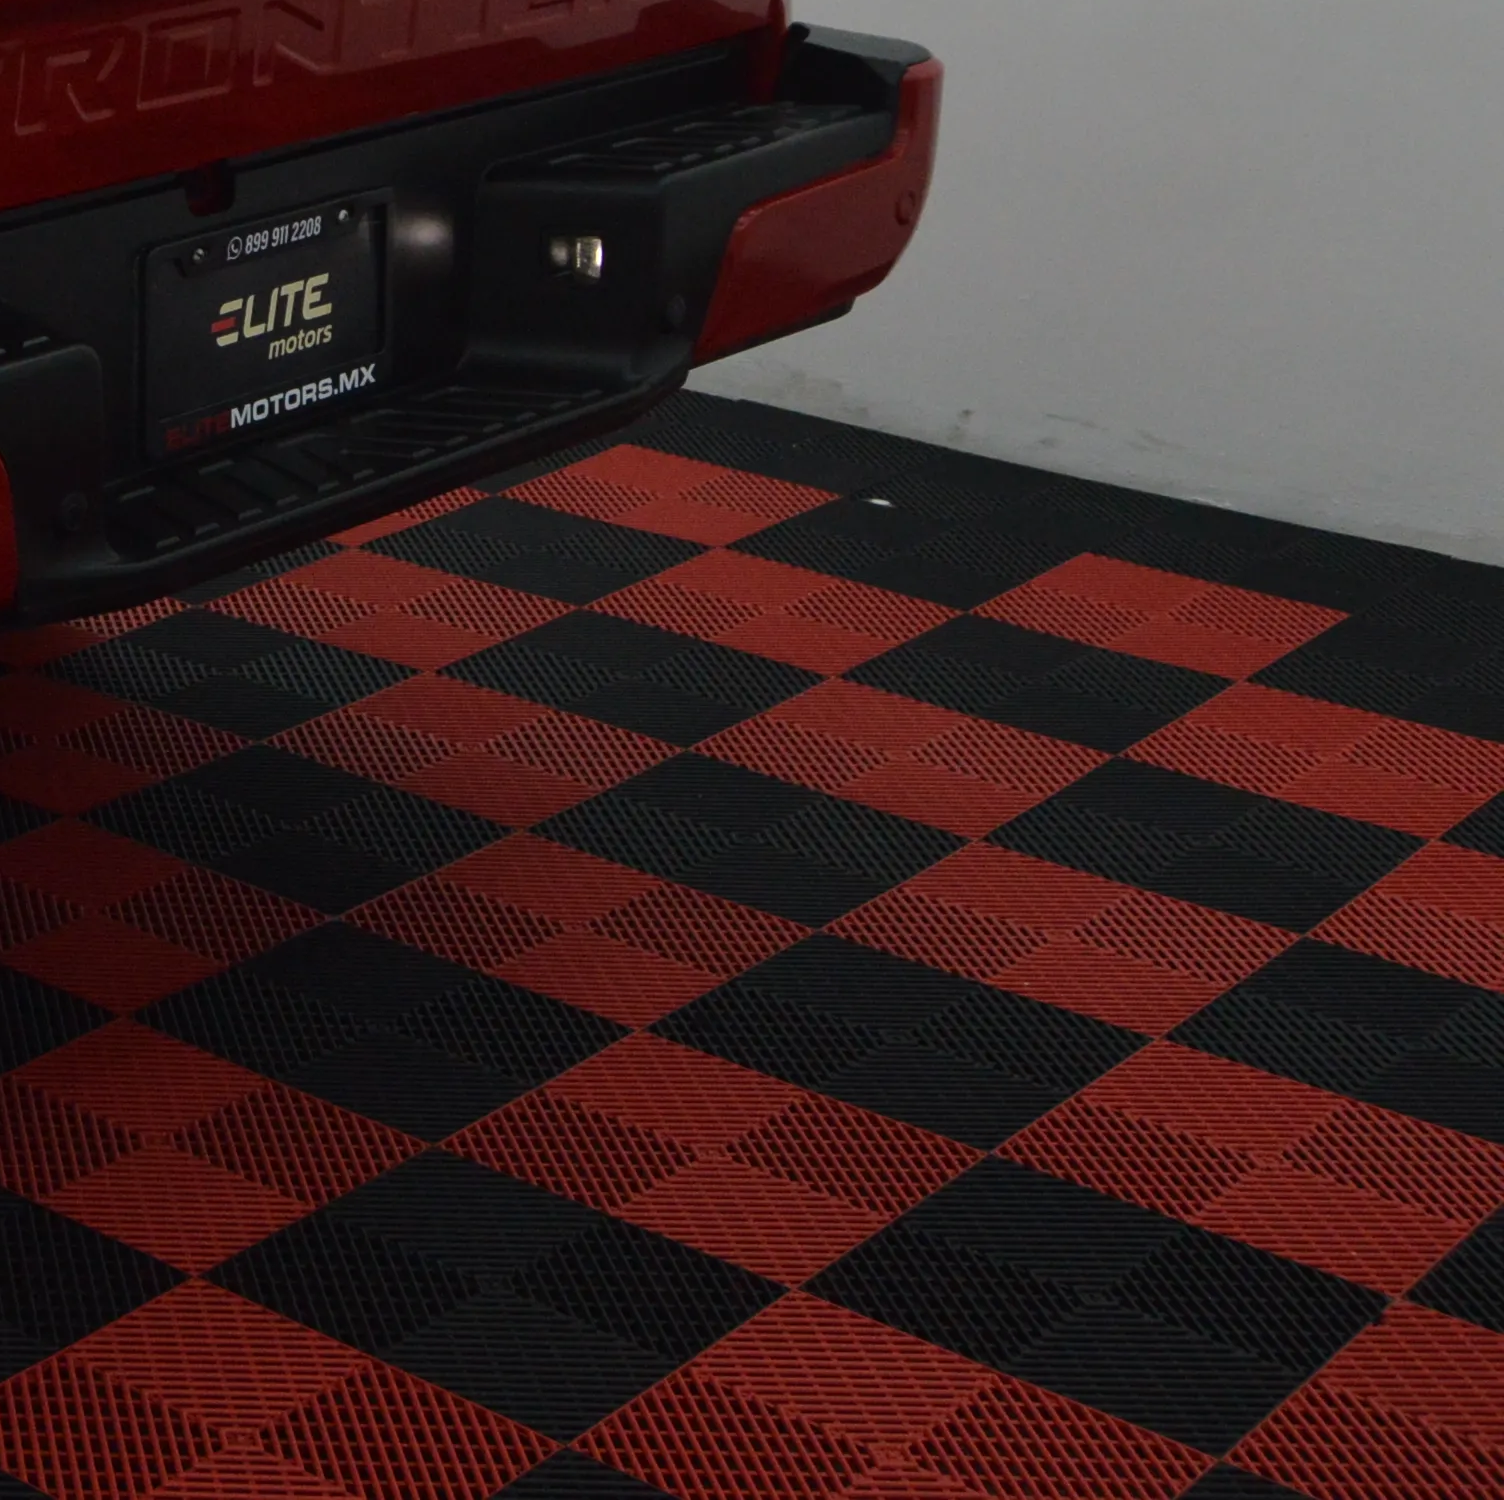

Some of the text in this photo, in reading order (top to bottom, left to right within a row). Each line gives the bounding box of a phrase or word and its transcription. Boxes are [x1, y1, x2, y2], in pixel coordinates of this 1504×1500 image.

[244, 215, 322, 255] 899 911 2208
[211, 272, 333, 347] ELITE
[268, 323, 333, 360] motors
